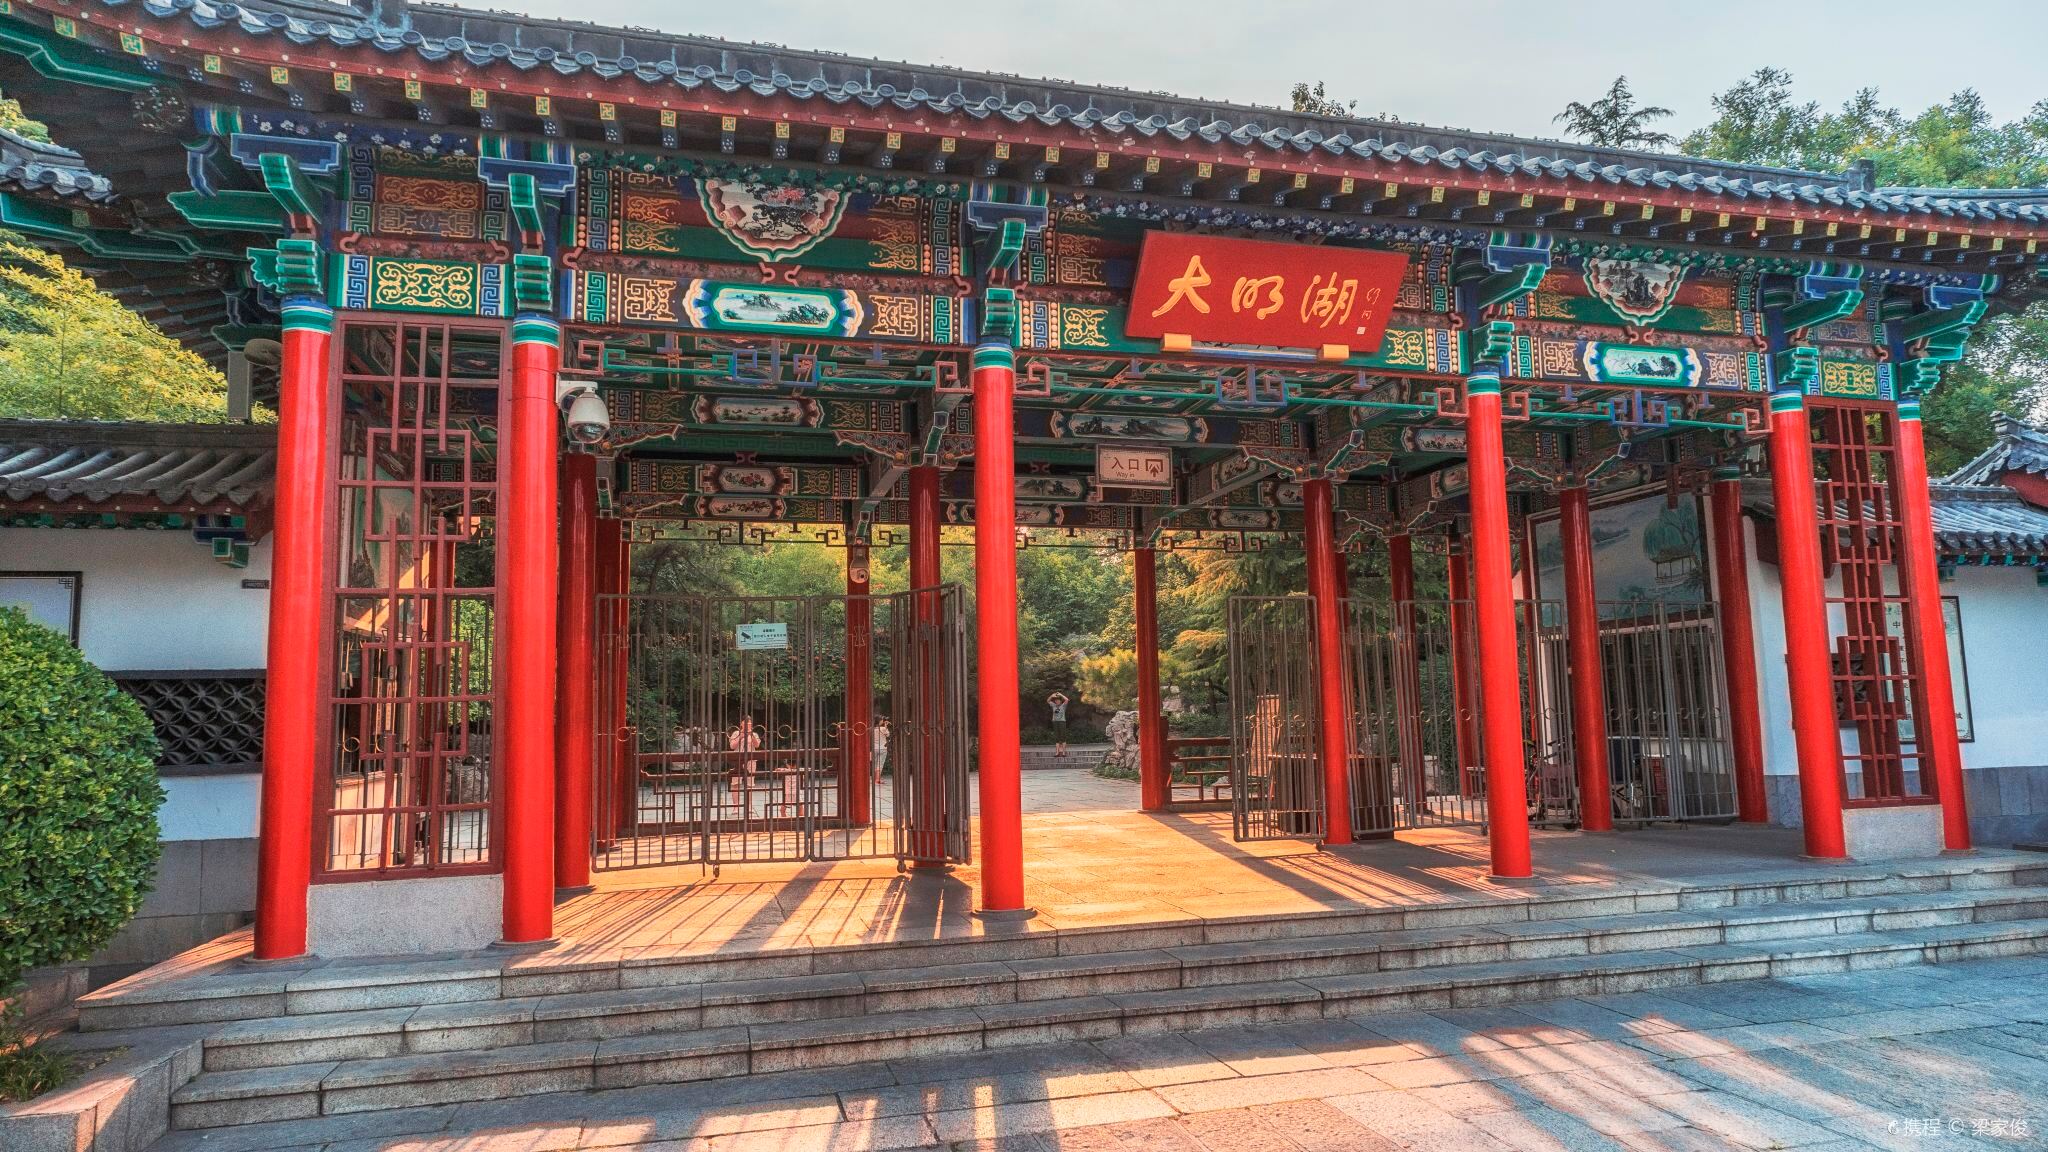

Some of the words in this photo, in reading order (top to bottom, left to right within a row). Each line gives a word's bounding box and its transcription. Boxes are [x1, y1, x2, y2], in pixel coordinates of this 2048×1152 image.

[1152, 254, 1358, 328] 大明湖
[1111, 456, 1139, 470] 入口
